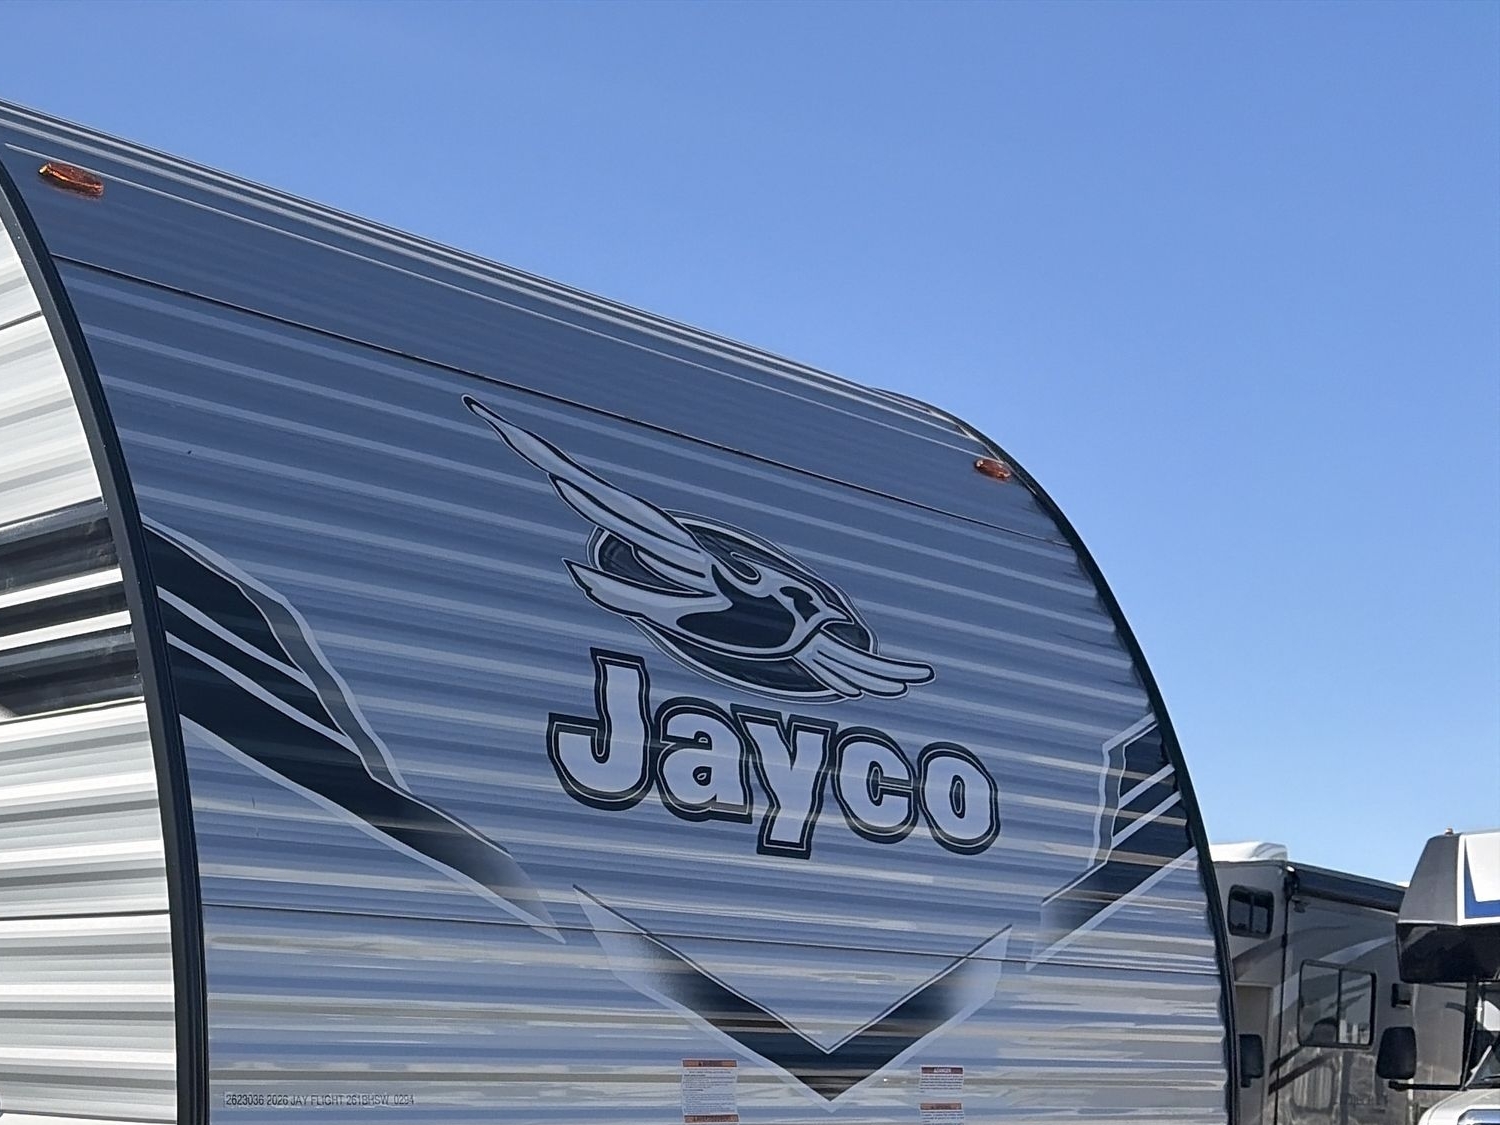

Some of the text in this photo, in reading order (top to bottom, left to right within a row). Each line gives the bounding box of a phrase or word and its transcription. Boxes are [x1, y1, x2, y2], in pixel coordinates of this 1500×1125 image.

[546, 647, 1000, 859] Jayco
[225, 1094, 265, 1106] 2623036
[266, 1094, 289, 1106] 2026
[290, 1094, 308, 1106] JAY
[310, 1094, 344, 1106] FLIGHT
